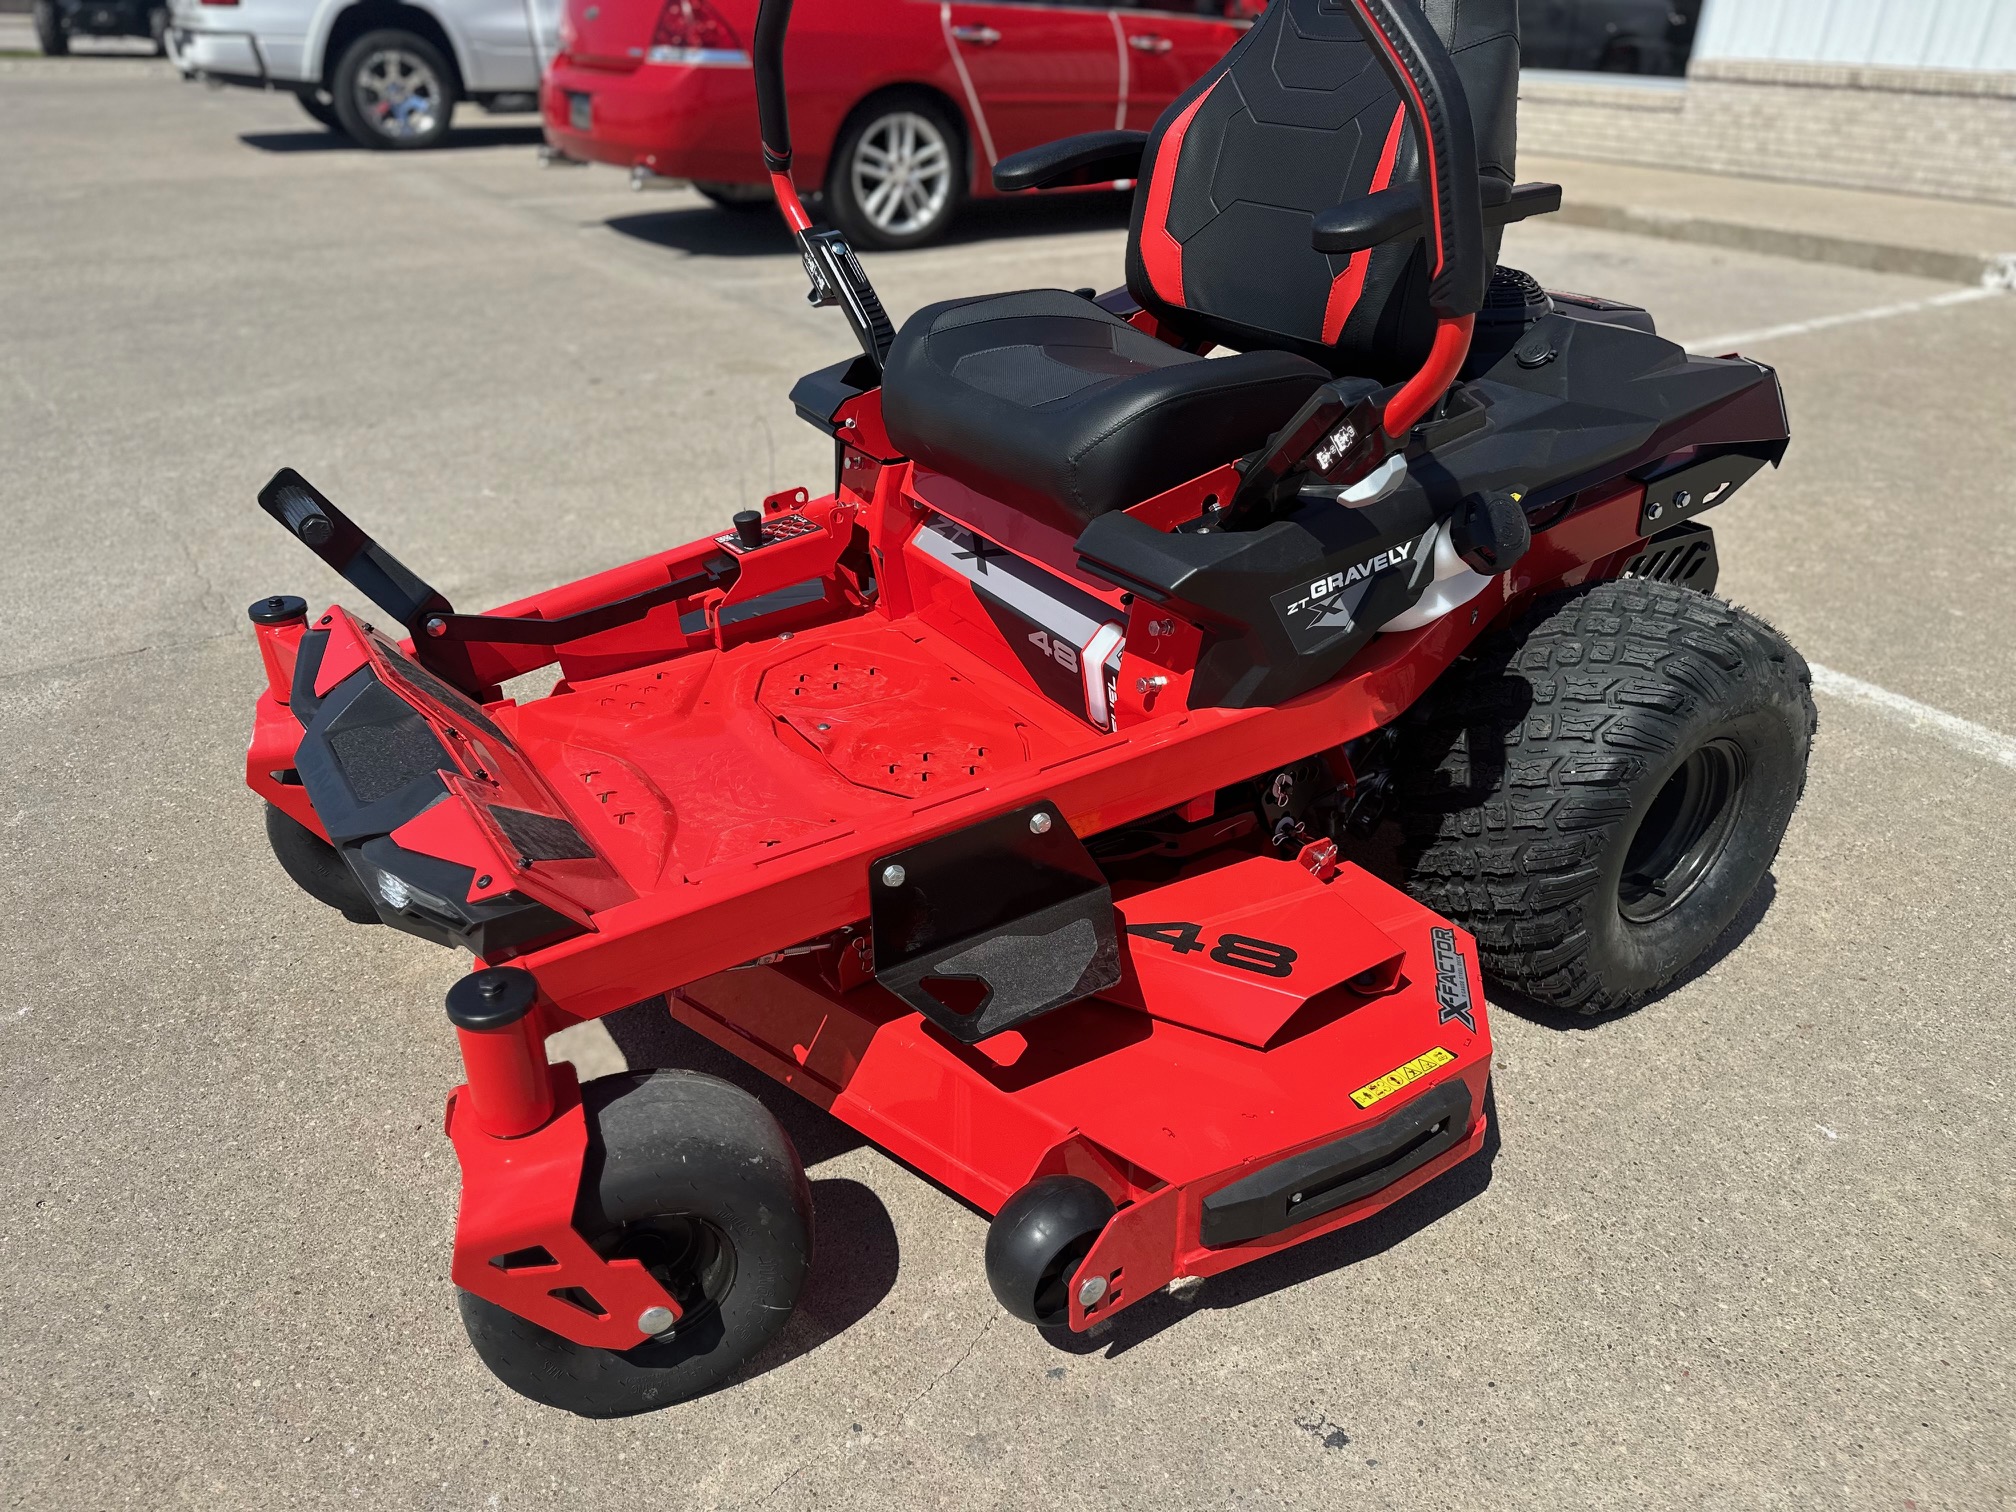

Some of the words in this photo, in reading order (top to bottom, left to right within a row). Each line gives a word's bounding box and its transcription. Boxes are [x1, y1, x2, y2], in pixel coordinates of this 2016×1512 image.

[928, 515, 972, 544] ZT
[950, 532, 1011, 577] X
[1310, 541, 1412, 599] GRAVELY
[1287, 597, 1310, 616] ZT
[1028, 630, 1079, 674] 48
[1124, 921, 1298, 978] 48
[1434, 929, 1471, 1026] X-FACTOR
